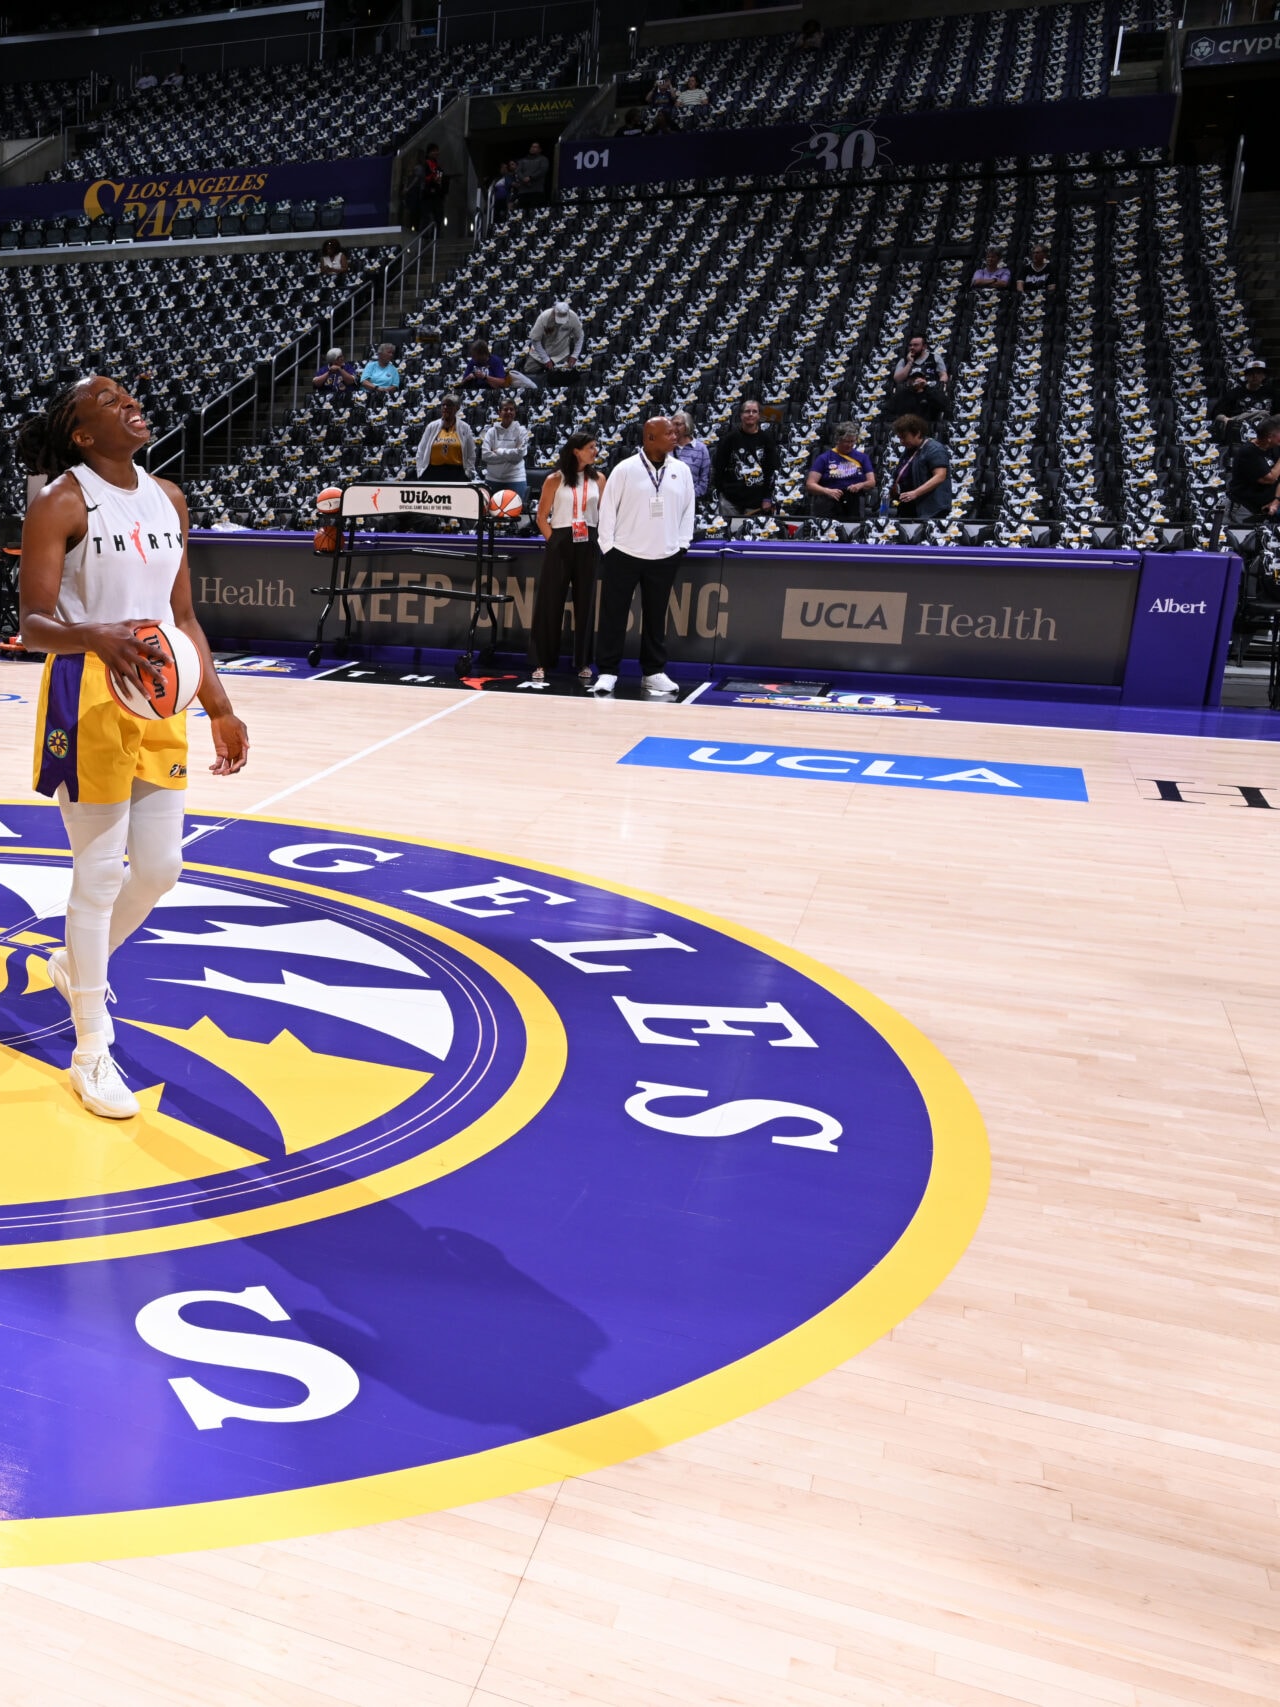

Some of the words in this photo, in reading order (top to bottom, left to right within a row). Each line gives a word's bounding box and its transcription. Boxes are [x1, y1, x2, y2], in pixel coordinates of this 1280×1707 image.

[573, 148, 610, 170] 101
[126, 181, 169, 199] LOS
[168, 173, 268, 196] ANGELES
[400, 490, 452, 504] Wilson
[198, 576, 296, 608] Health
[338, 570, 453, 625] KEEP
[471, 575, 535, 630] ON
[1148, 598, 1207, 614] Albert
[799, 602, 888, 630] UCLA
[915, 603, 1058, 642] Health
[688, 747, 1022, 788] UCLA
